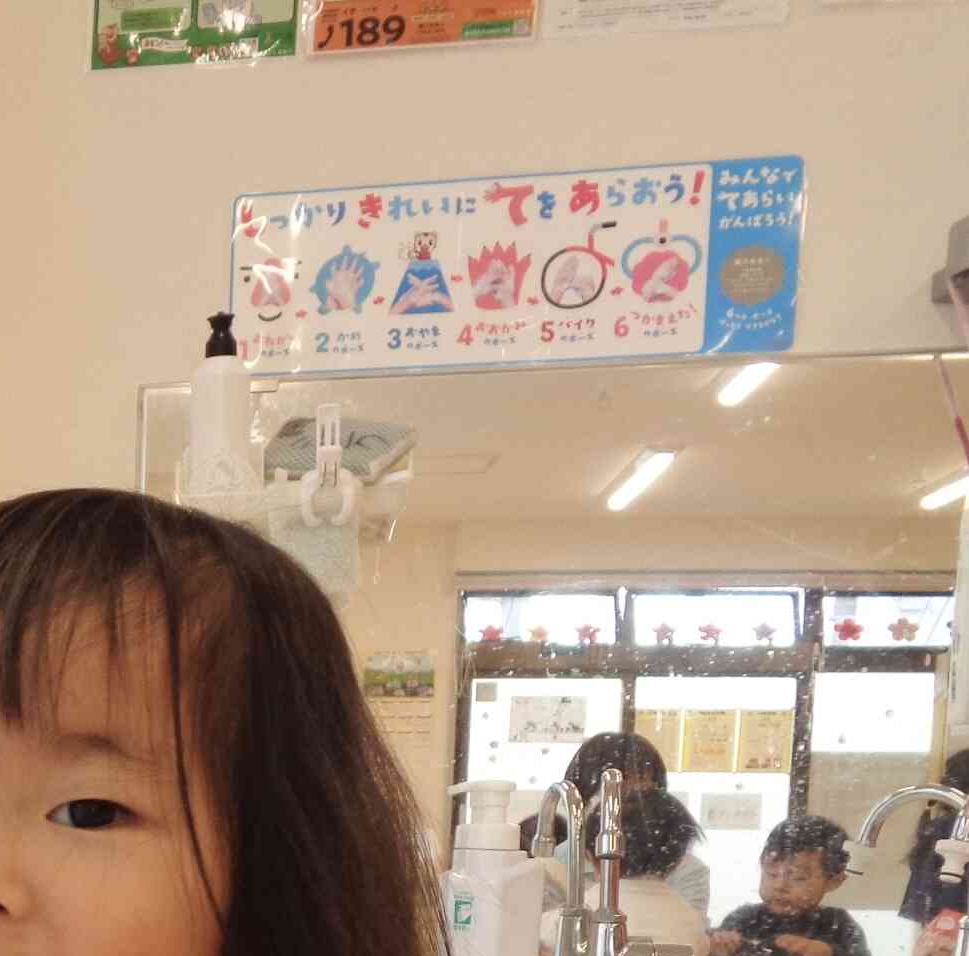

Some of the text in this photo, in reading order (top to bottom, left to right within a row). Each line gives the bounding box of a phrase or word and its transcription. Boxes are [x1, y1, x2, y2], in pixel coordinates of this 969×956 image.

[340, 15, 406, 47] 189
[456, 324, 475, 346] 4
[540, 320, 556, 343] 5
[613, 315, 629, 337] 6
[316, 332, 330, 352] 2
[388, 328, 401, 350] 3
